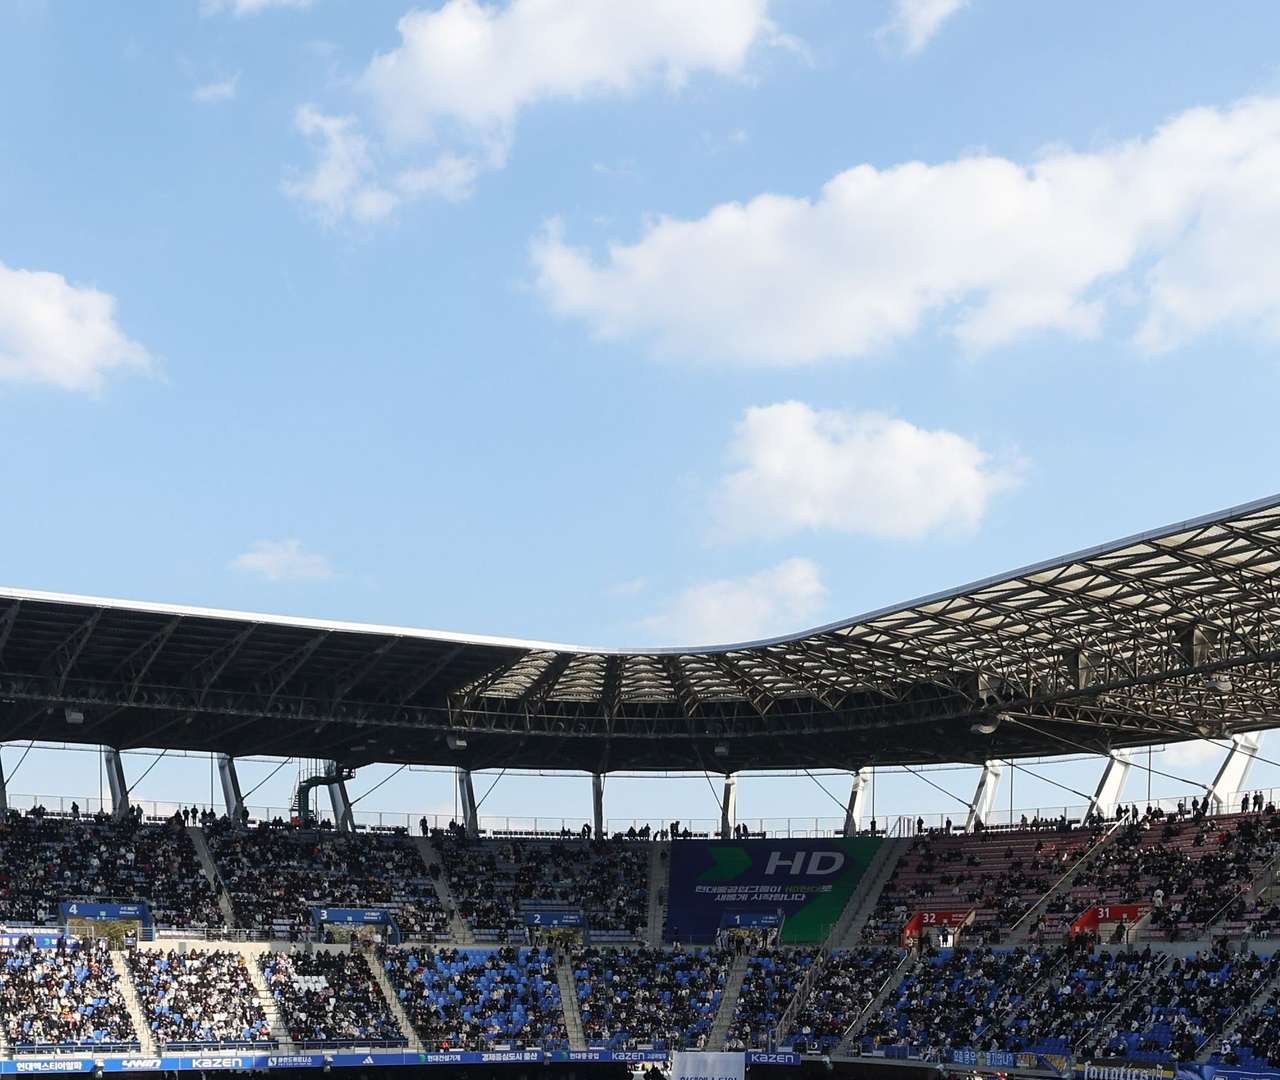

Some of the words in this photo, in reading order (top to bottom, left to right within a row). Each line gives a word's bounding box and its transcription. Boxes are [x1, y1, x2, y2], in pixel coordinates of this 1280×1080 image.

[764, 851, 844, 876] HD
[68, 904, 78, 915] 4
[320, 909, 328, 920] 3
[1097, 907, 1111, 918] 31
[533, 914, 541, 924] 2
[735, 914, 741, 925] 1
[922, 912, 936, 923] 32
